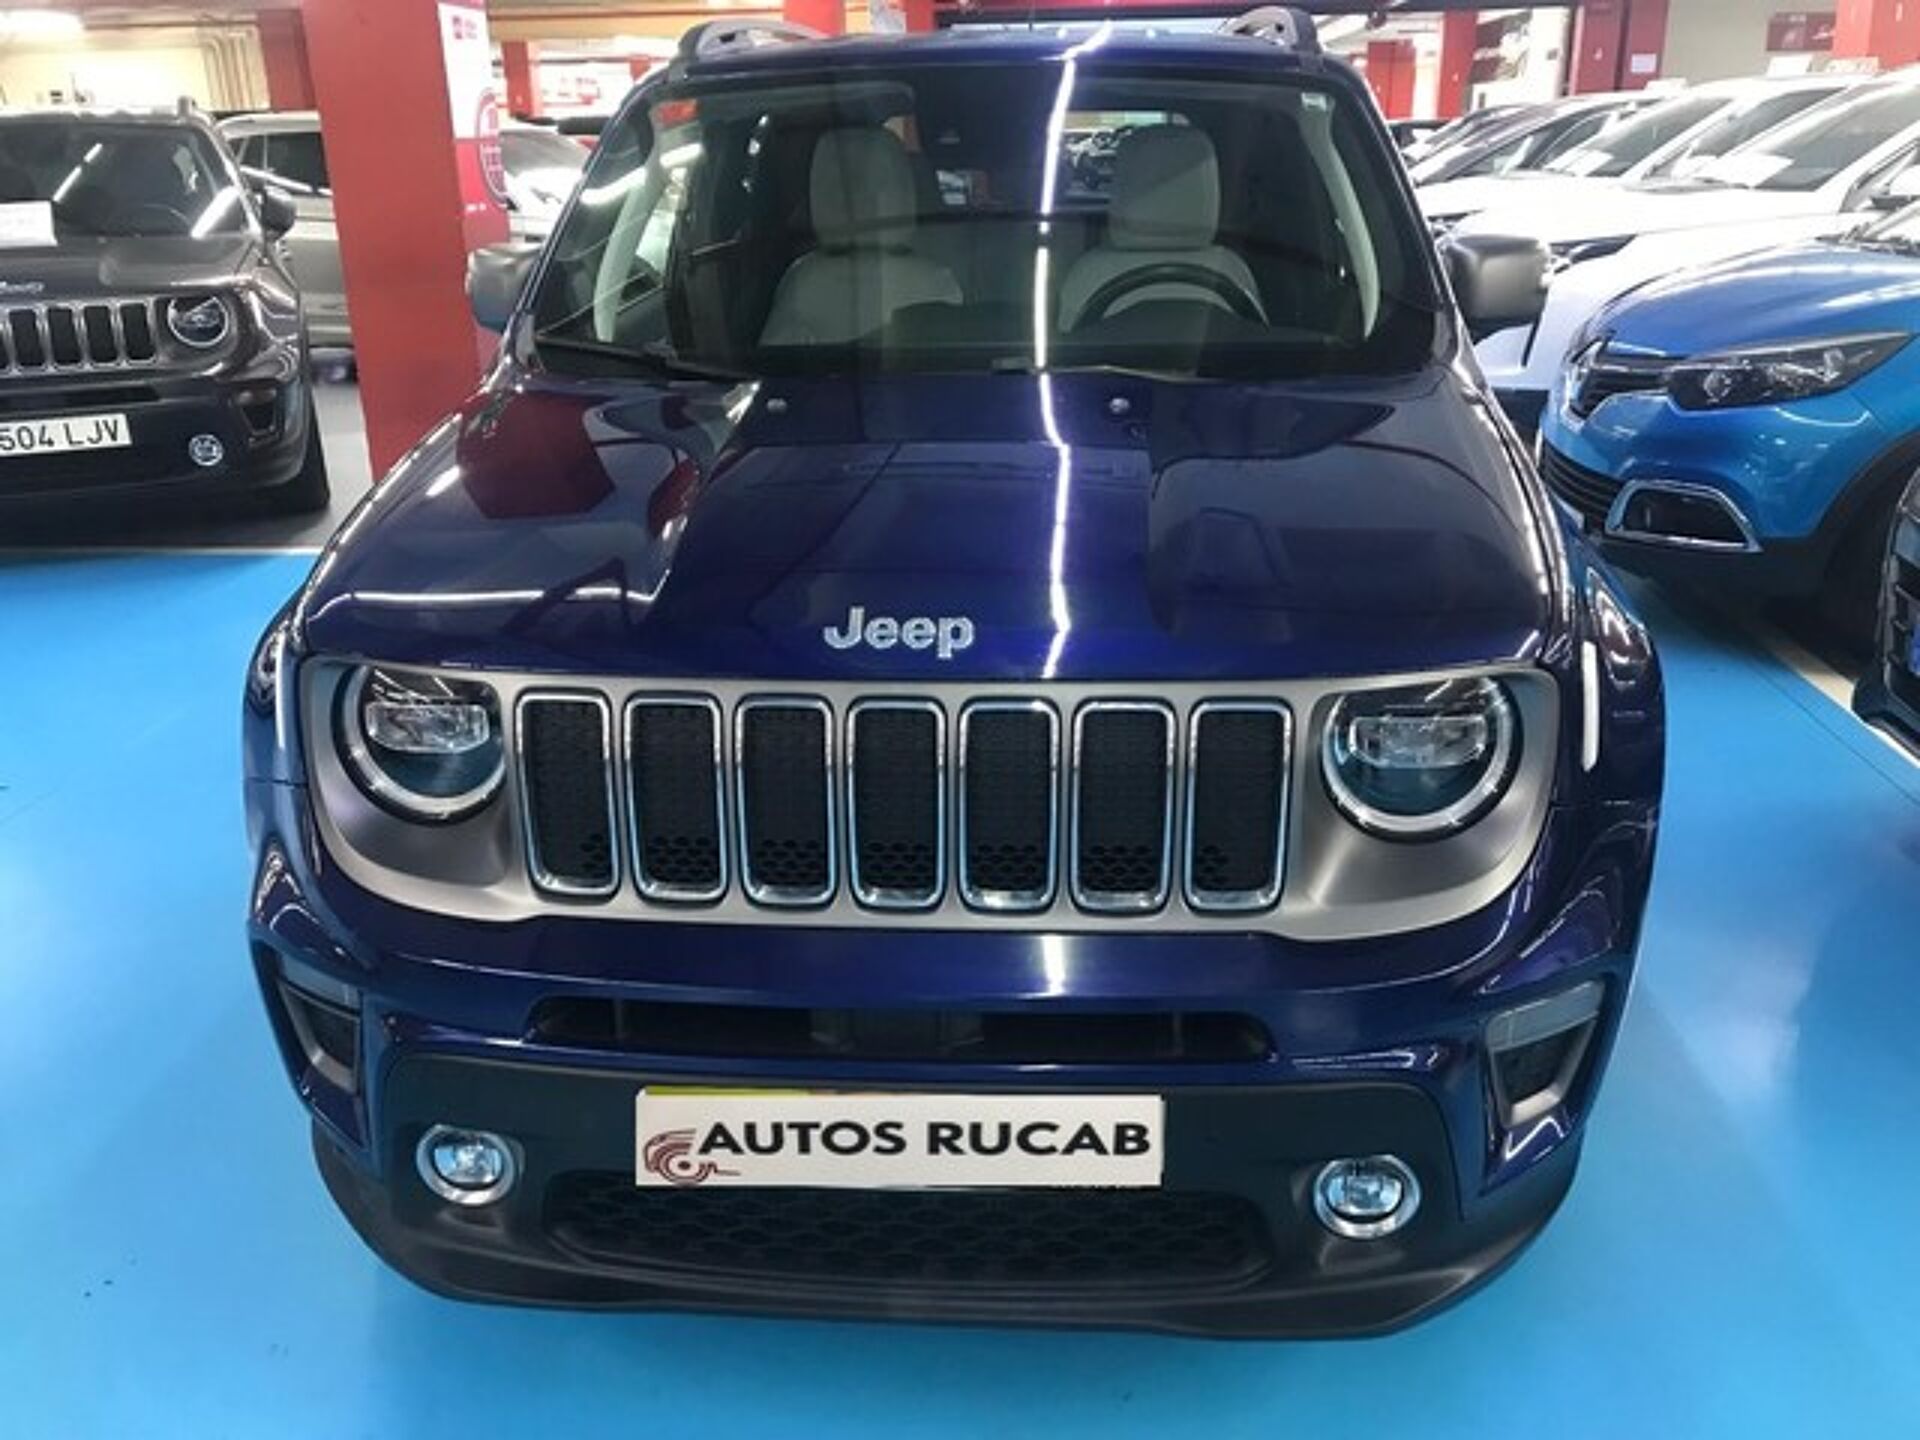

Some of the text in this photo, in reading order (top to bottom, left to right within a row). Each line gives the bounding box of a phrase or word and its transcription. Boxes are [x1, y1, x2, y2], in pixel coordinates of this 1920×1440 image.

[63, 419, 118, 445] LJV
[823, 606, 975, 659] Jeep
[698, 1120, 1151, 1156] AUTOS RUCAB
